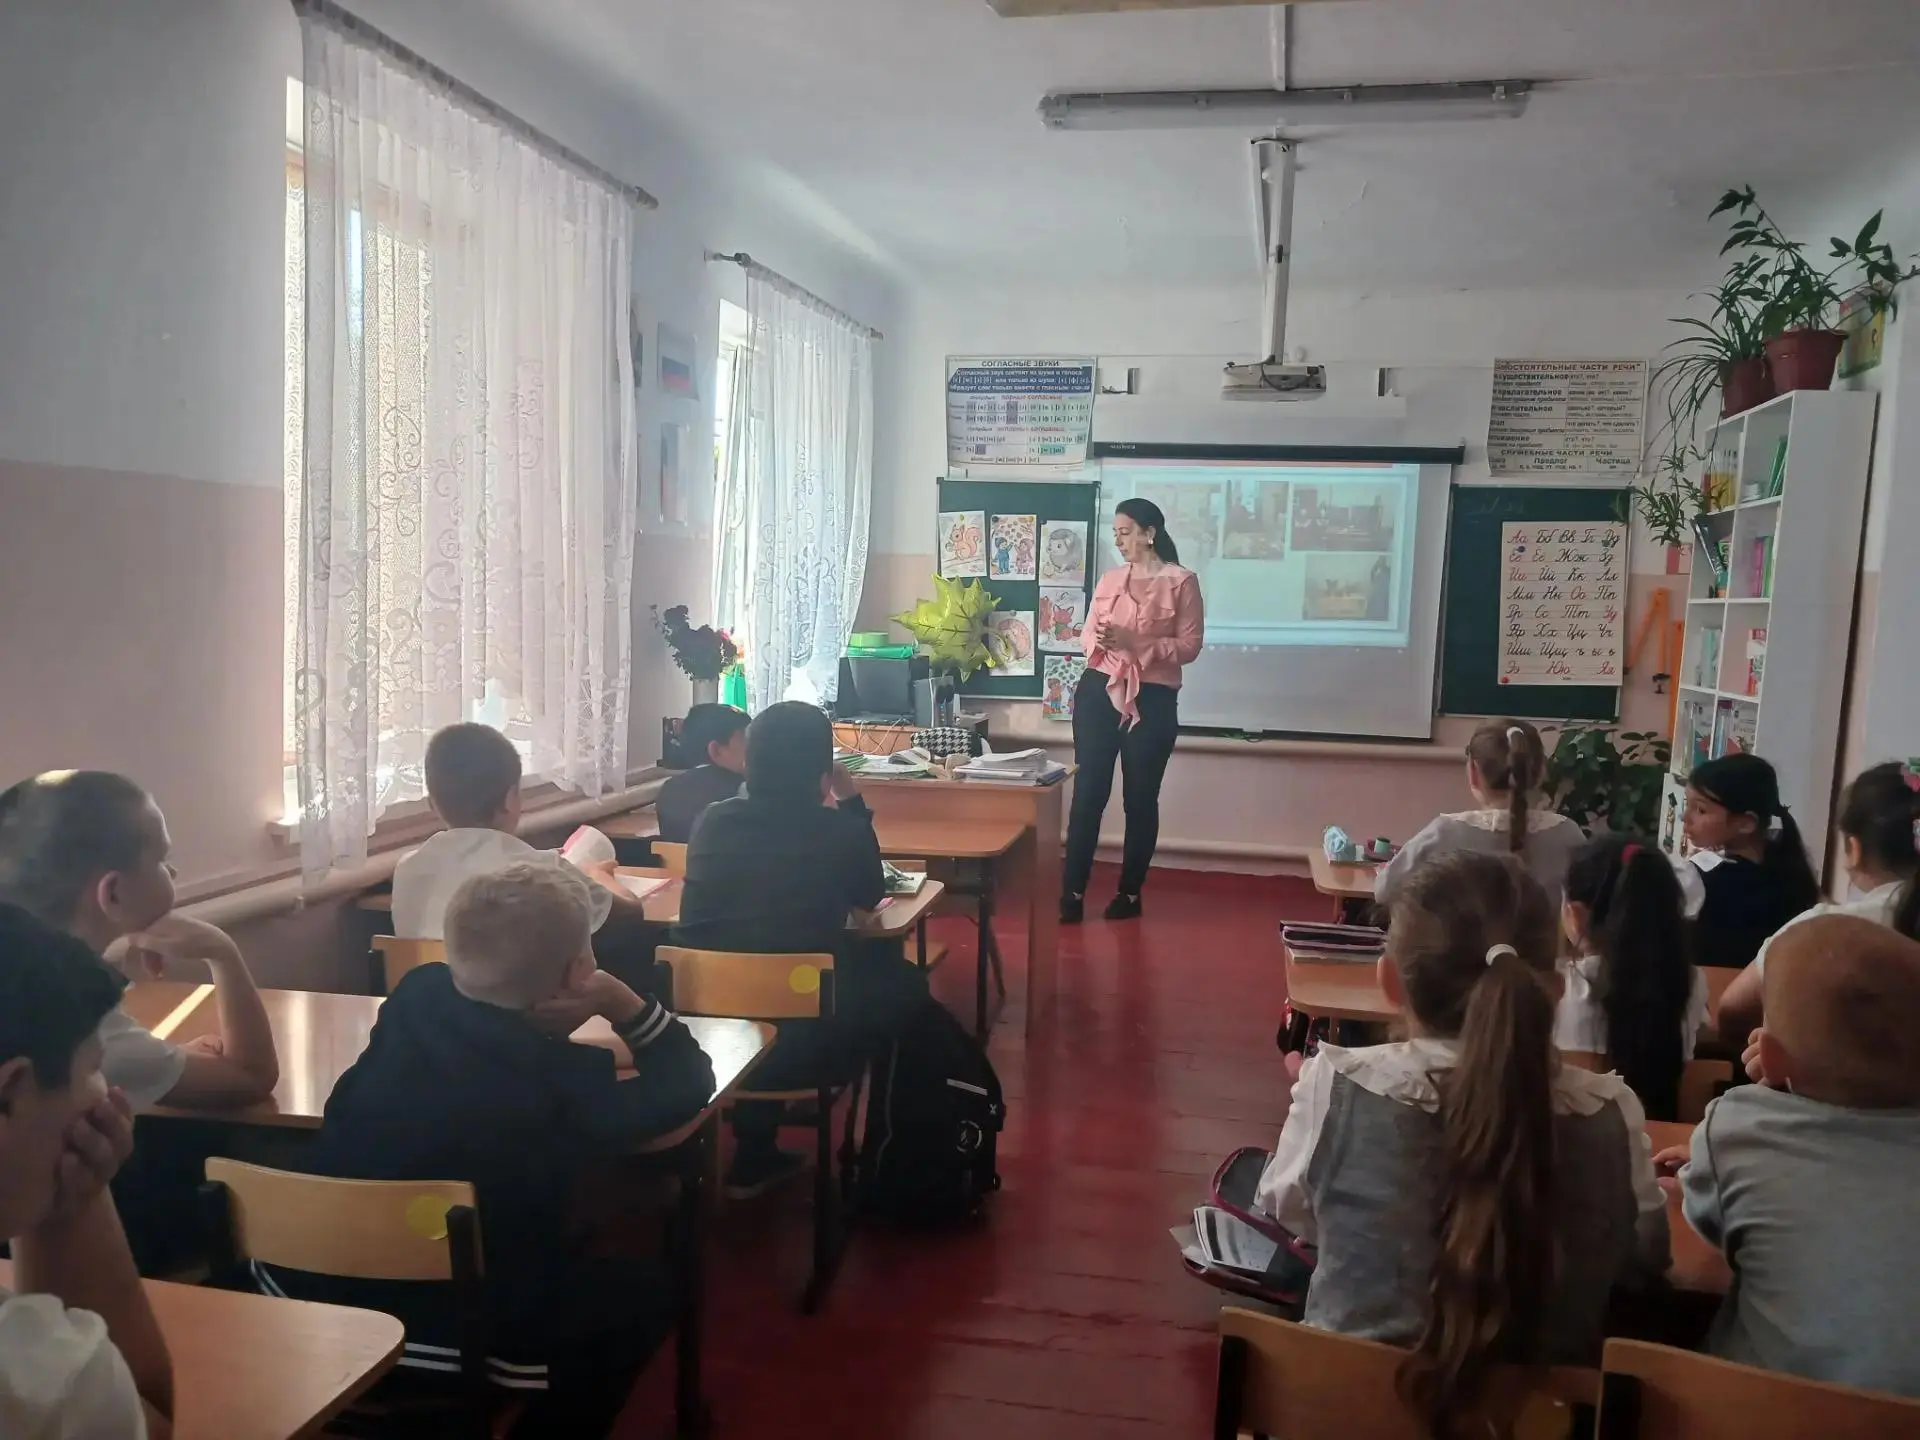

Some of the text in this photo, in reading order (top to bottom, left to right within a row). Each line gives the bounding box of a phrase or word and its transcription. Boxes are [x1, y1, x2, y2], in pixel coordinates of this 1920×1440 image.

[1580, 363, 1608, 371] ЧАСТИ
[1507, 529, 1528, 544] Аа
[1536, 529, 1559, 543] Бб
[1558, 529, 1577, 544] Вв
[1581, 529, 1597, 543] Гг
[1555, 548, 1589, 562] Жж
[1599, 548, 1615, 567] Зз
[1509, 566, 1528, 581] Ии
[1566, 567, 1587, 581] Кк
[1596, 566, 1619, 581] Лл
[1507, 584, 1618, 600] Мм Нн Оо Пп
[1506, 603, 1618, 624] Рр Сс Тт Уу
[1506, 622, 1614, 643] Фф Хх Цц Чч
[1507, 641, 1532, 656] Шш
[1540, 641, 1570, 659] Щщ
[1505, 660, 1617, 675] Ээ Юю Яя
